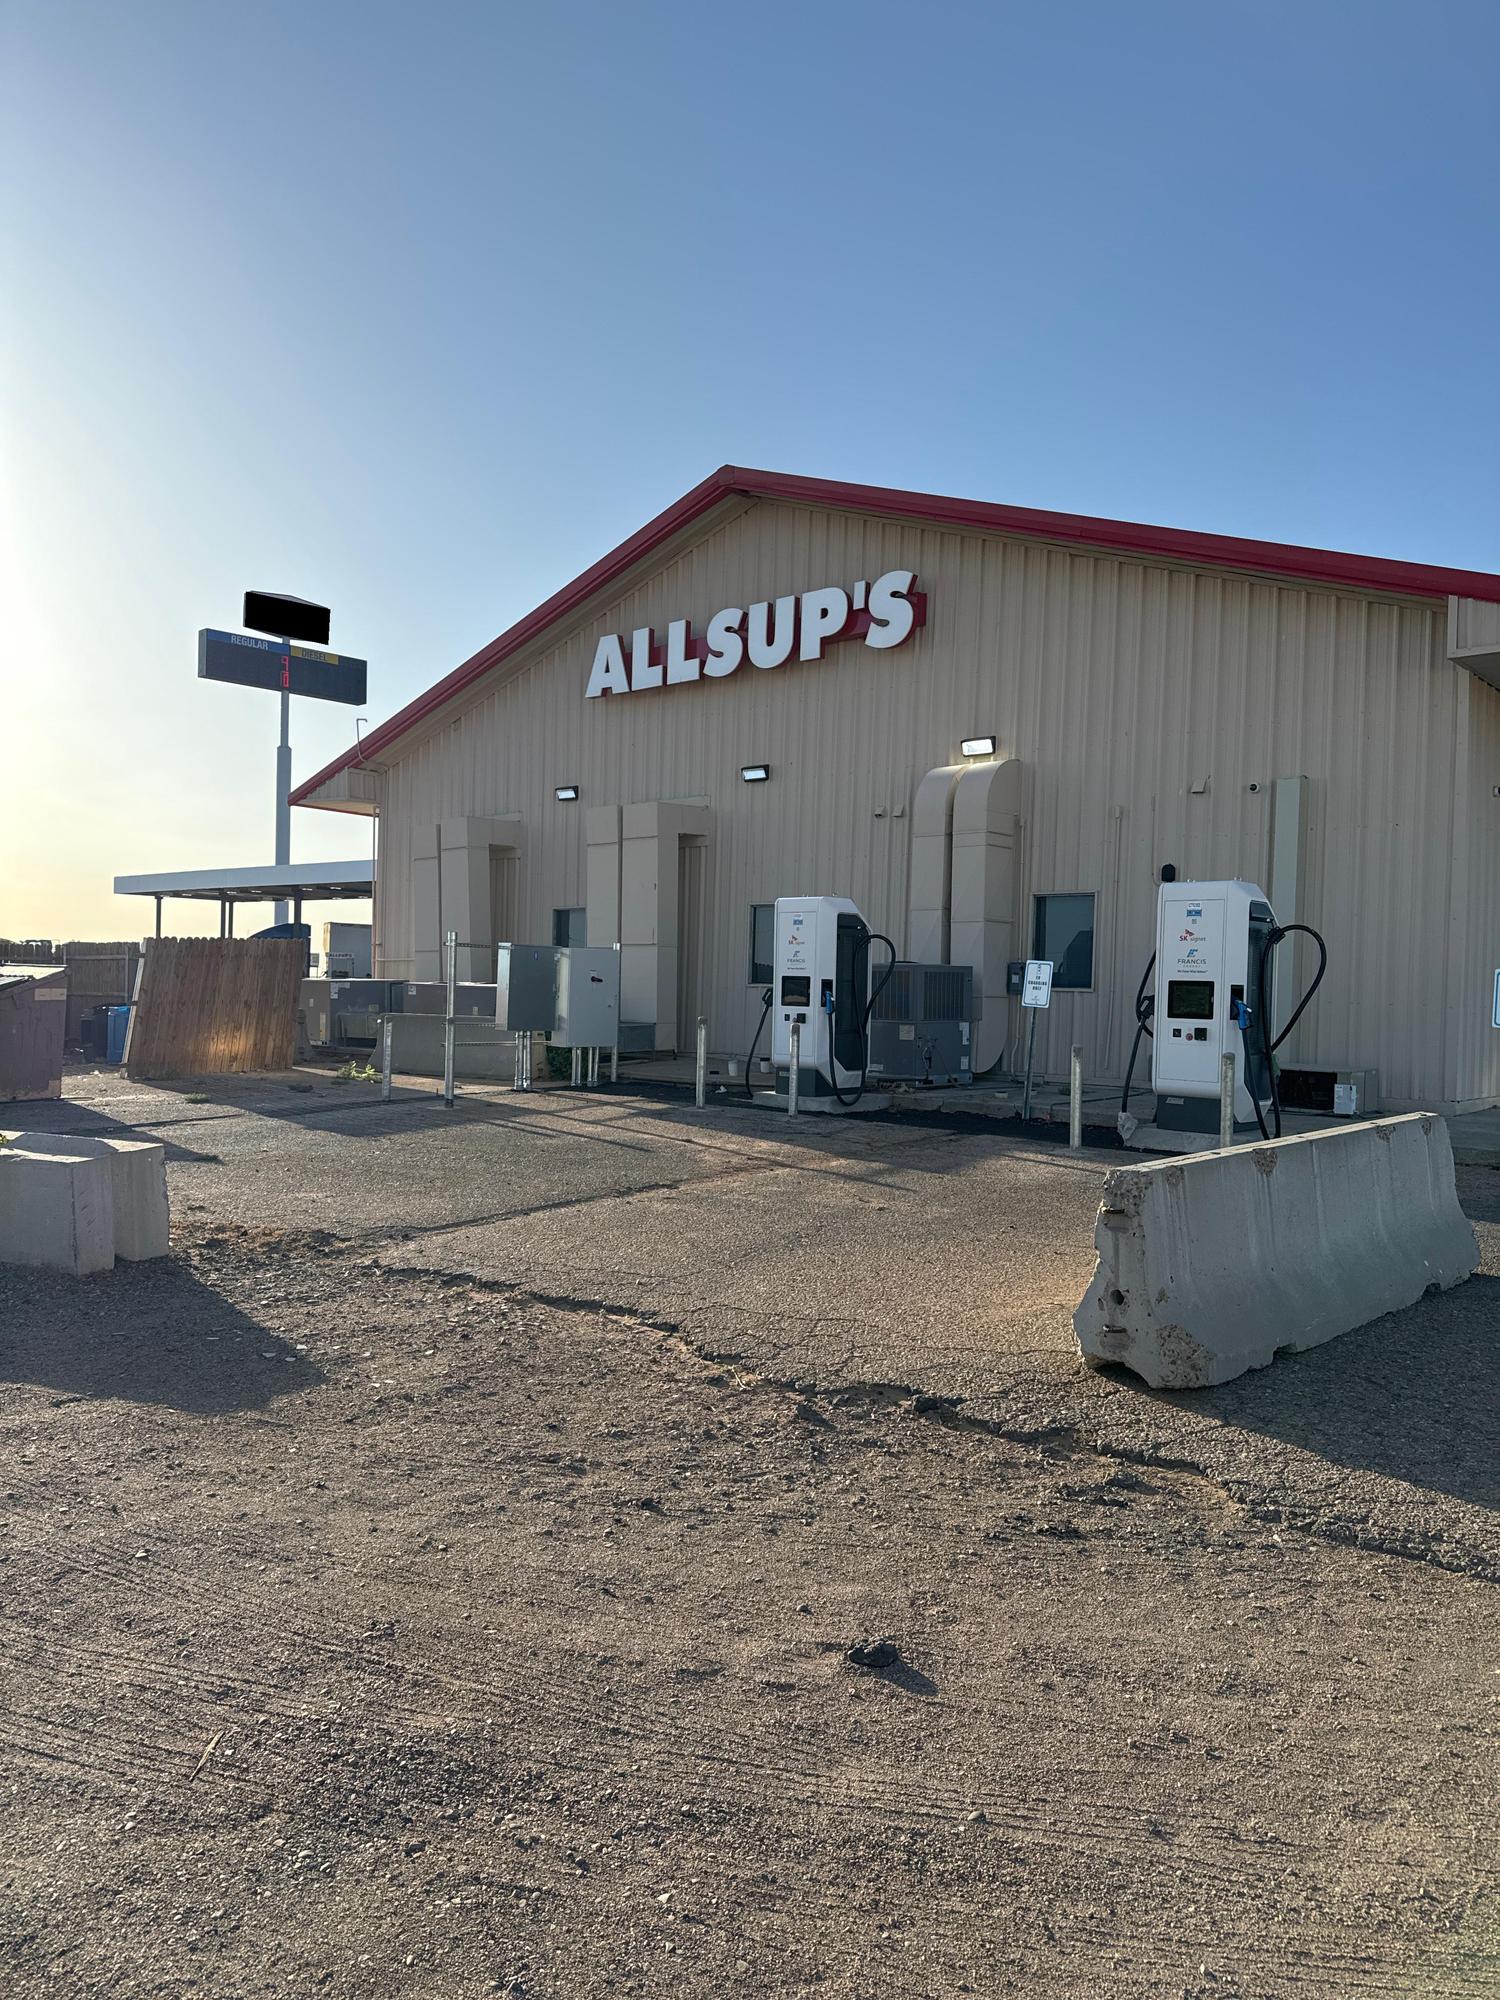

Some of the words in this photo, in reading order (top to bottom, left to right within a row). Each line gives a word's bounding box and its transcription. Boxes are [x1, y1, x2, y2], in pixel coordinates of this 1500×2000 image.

[585, 570, 917, 698] ALLSUP'S
[231, 635, 269, 650] REGULAR
[301, 650, 328, 662] DIESEL
